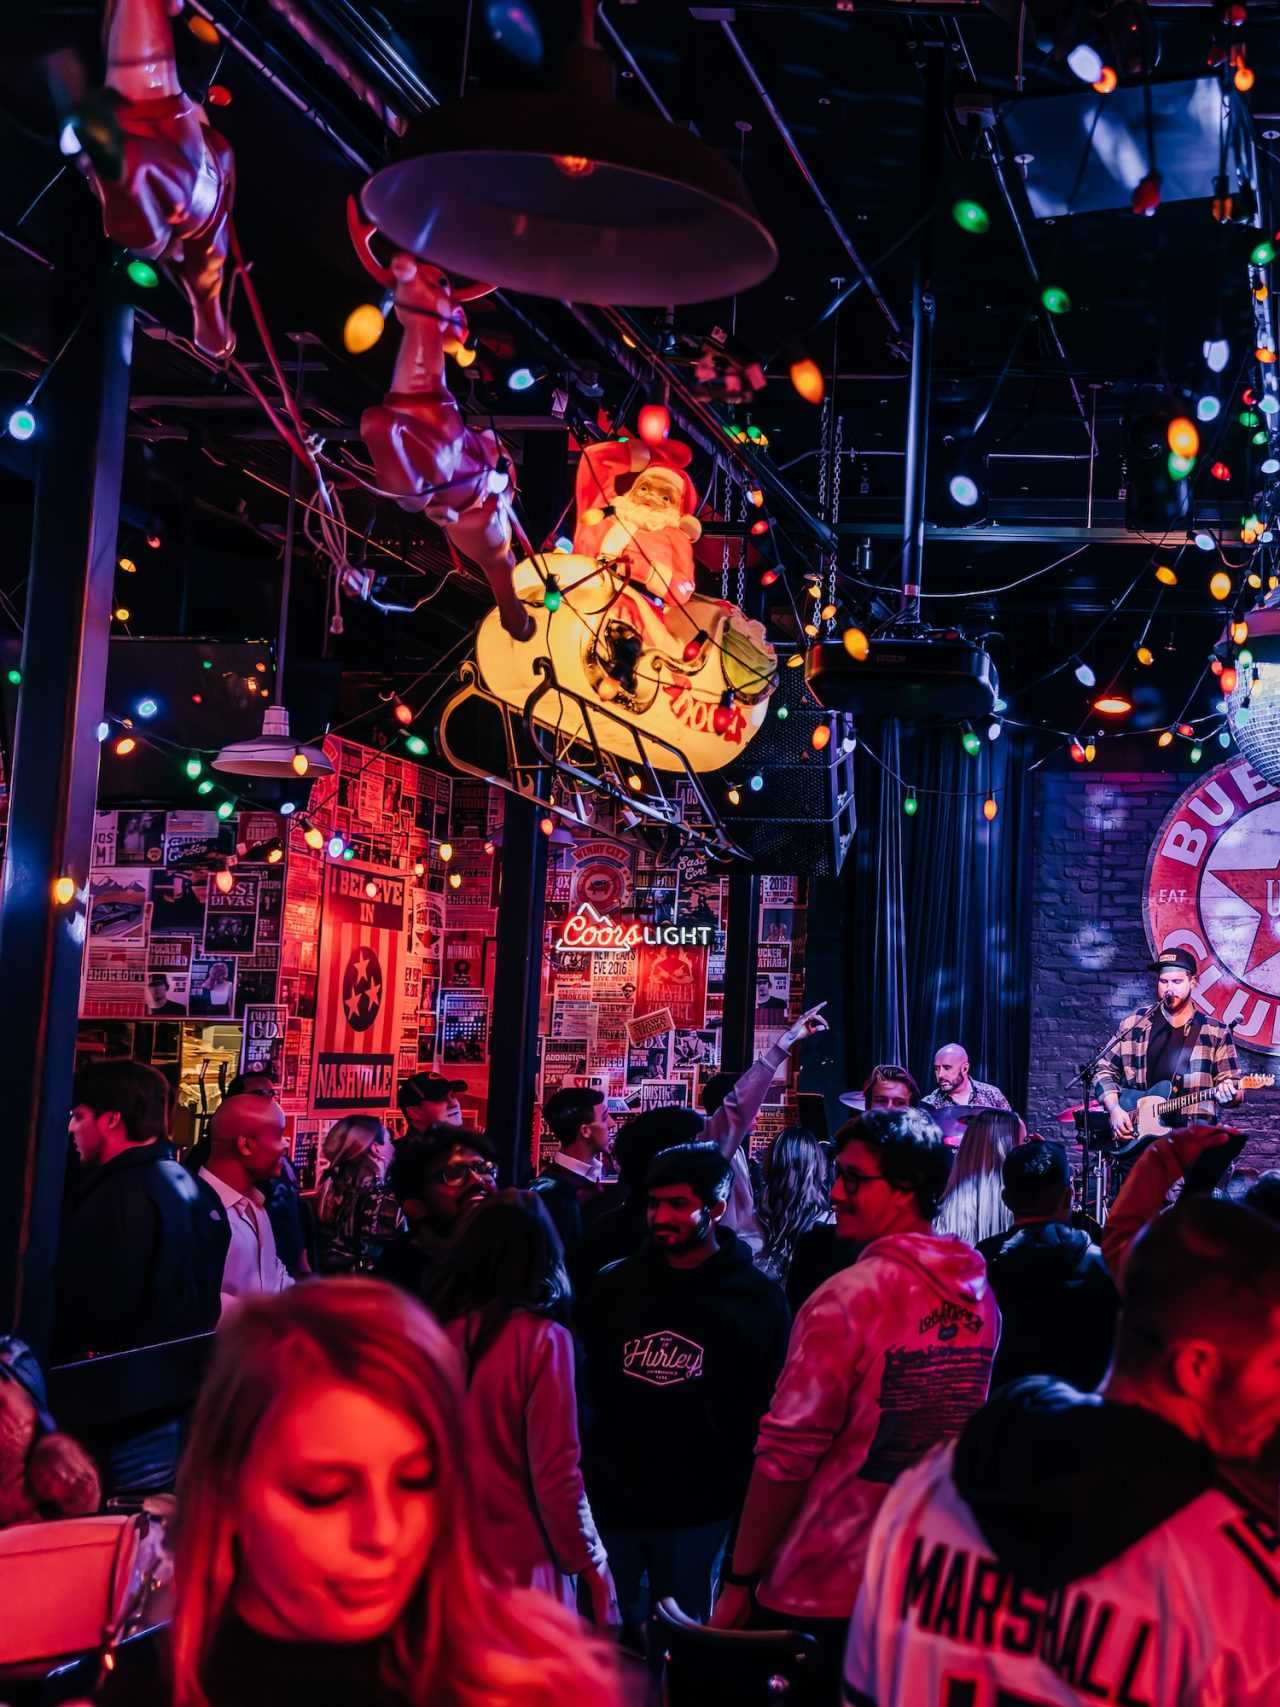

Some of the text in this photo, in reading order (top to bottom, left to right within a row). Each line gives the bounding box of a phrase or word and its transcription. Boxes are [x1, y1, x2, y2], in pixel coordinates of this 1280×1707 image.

[340, 870, 403, 907] BELEVE
[1159, 889, 1186, 903] EAT
[359, 903, 375, 924] IN
[562, 915, 712, 946] Coors LIGHT
[757, 948, 783, 958] UCKER
[593, 961, 608, 975] EVE
[608, 961, 628, 976] 2016
[315, 1063, 392, 1099] NASHVILLE
[643, 1085, 671, 1100] DUSTIN
[624, 1339, 702, 1378] Hurley
[903, 1534, 1152, 1707] MARSHALL
